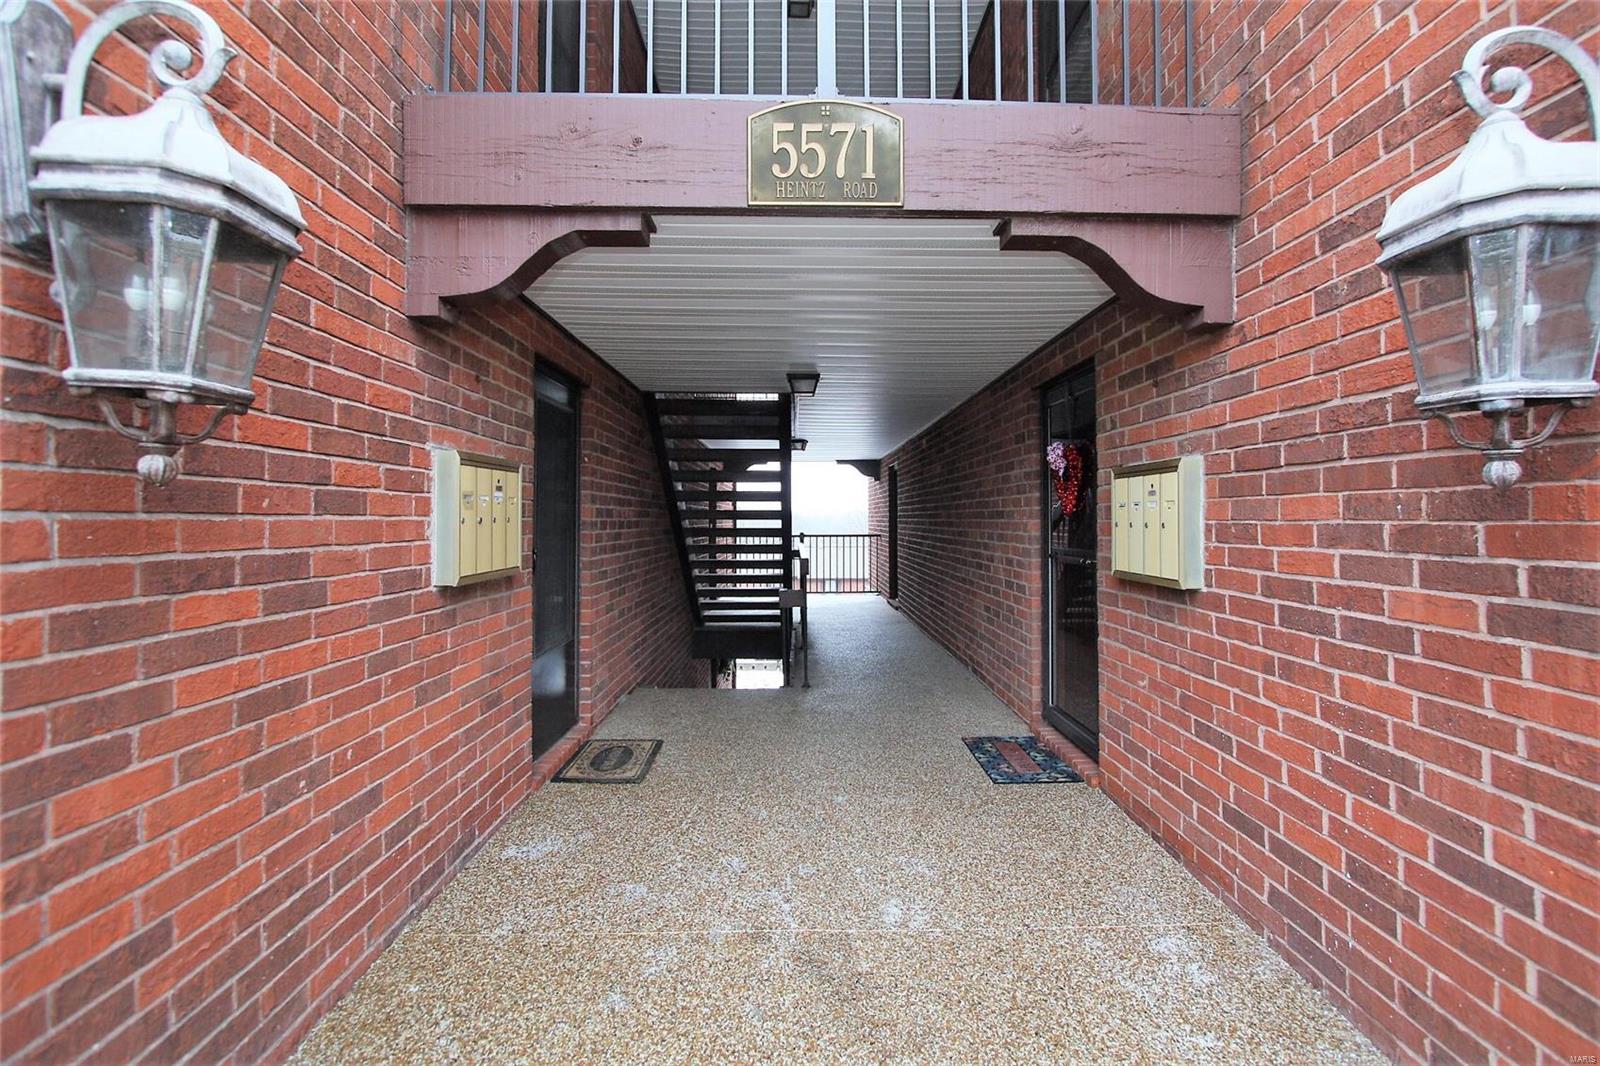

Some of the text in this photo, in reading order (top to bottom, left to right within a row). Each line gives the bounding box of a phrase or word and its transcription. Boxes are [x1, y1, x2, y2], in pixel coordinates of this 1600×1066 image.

[771, 122, 876, 179] 5571
[775, 181, 878, 199] HEINTZ ROAD
